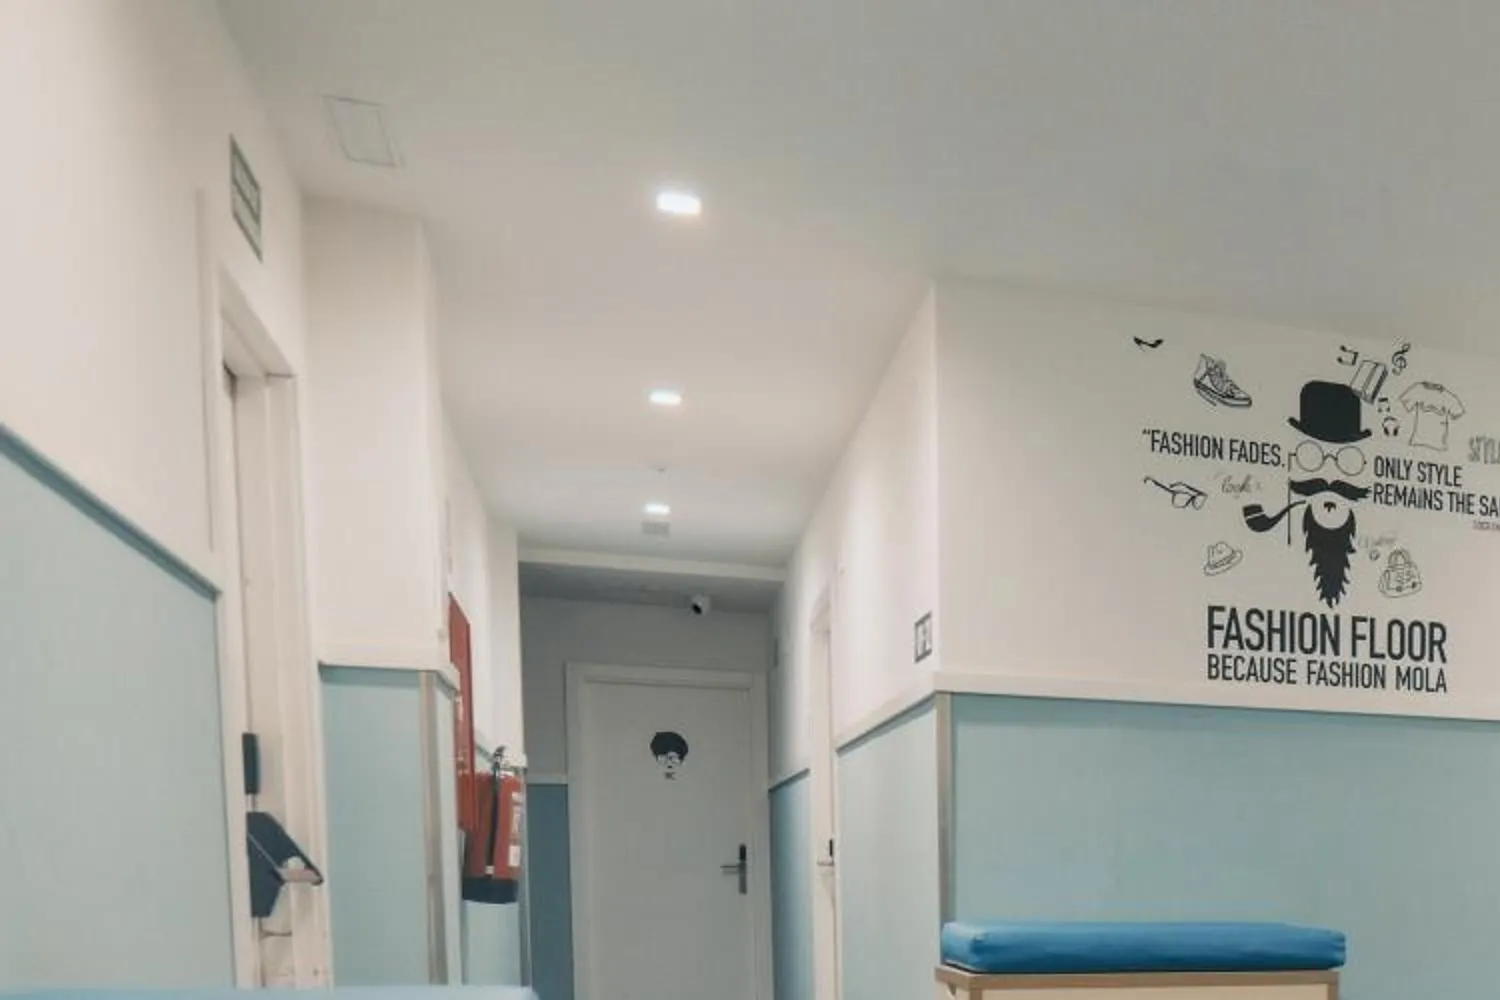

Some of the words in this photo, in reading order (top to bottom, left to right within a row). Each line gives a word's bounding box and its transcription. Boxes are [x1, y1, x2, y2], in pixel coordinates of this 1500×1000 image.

[1373, 455, 1413, 481] ONLY
[1417, 461, 1463, 487] STYLE
[1373, 482, 1443, 511] REMAINS
[1447, 490, 1475, 515] THE
[1207, 605, 1341, 657] FASHION
[1351, 615, 1447, 664] FLOOR
[1207, 653, 1297, 685] BECAUSE
[1307, 659, 1386, 689] FASHION
[1395, 665, 1447, 693] MOLA
